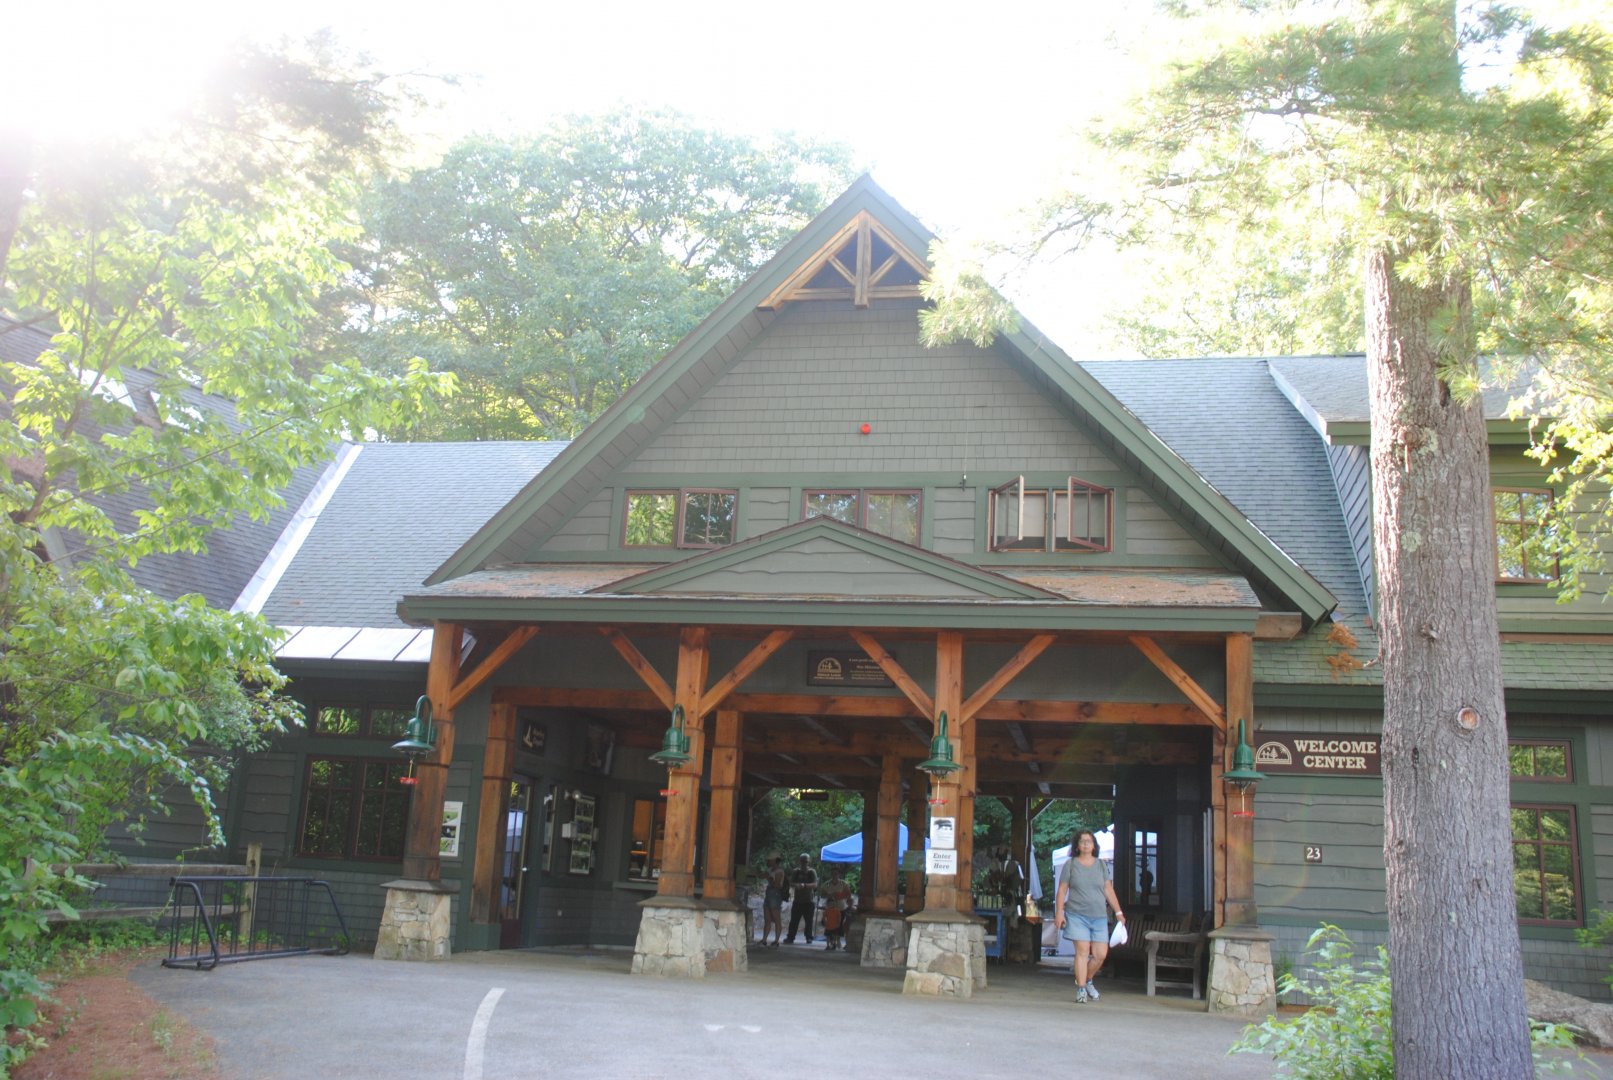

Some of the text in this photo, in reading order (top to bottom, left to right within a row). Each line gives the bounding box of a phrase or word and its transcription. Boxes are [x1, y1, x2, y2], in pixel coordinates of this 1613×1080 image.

[1293, 739, 1377, 754] WELCOME
[1303, 755, 1367, 769] CENTER
[932, 852, 952, 860] Enter
[1306, 846, 1321, 860] 23
[933, 862, 951, 870] Here
